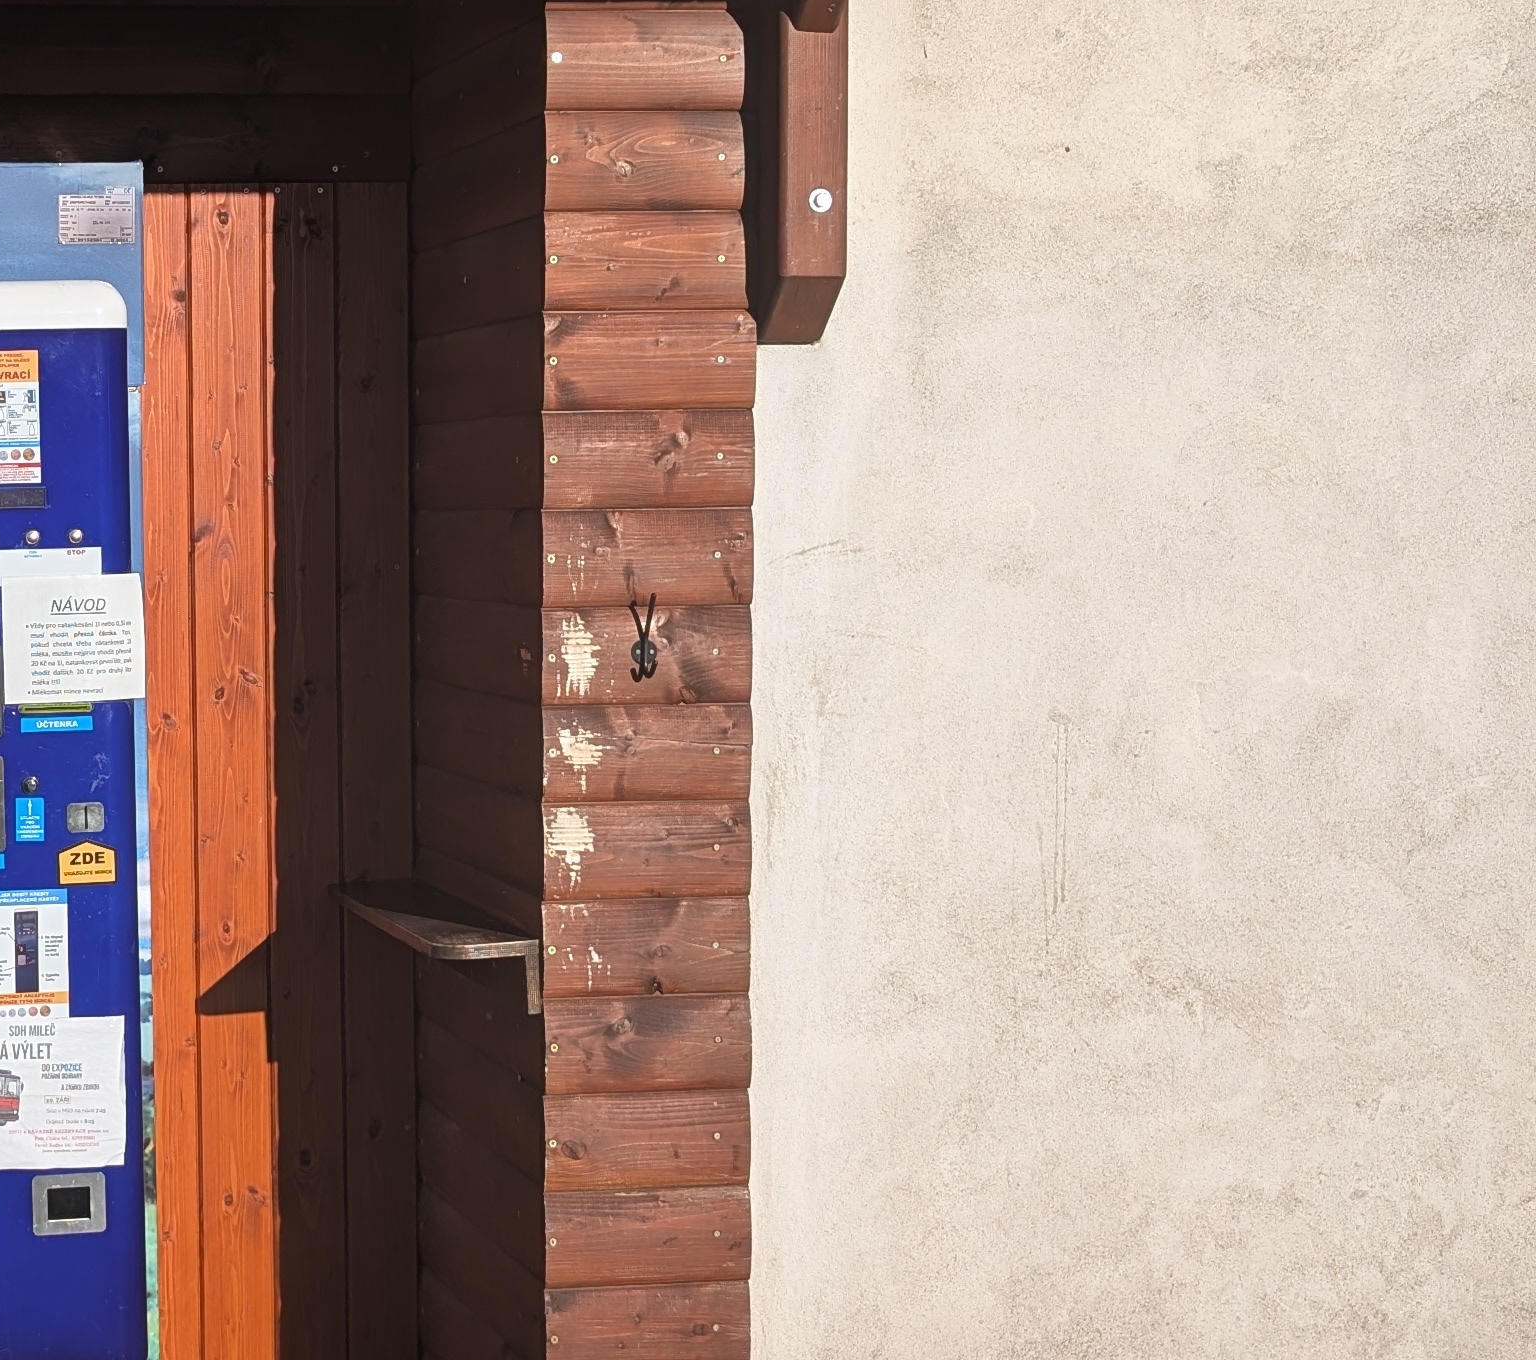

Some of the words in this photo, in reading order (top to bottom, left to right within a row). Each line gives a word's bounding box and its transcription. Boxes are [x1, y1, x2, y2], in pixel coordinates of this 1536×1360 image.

[51, 596, 106, 612] NÁVOD
[36, 720, 78, 728] ÚČTENKA
[70, 852, 105, 865] ZDE
[9, 1025, 26, 1036] SDH
[29, 1023, 55, 1036] MILEČ
[12, 1041, 53, 1060] VÝLET
[42, 1064, 50, 1072] DO
[52, 1063, 82, 1071] EXPOZICE
